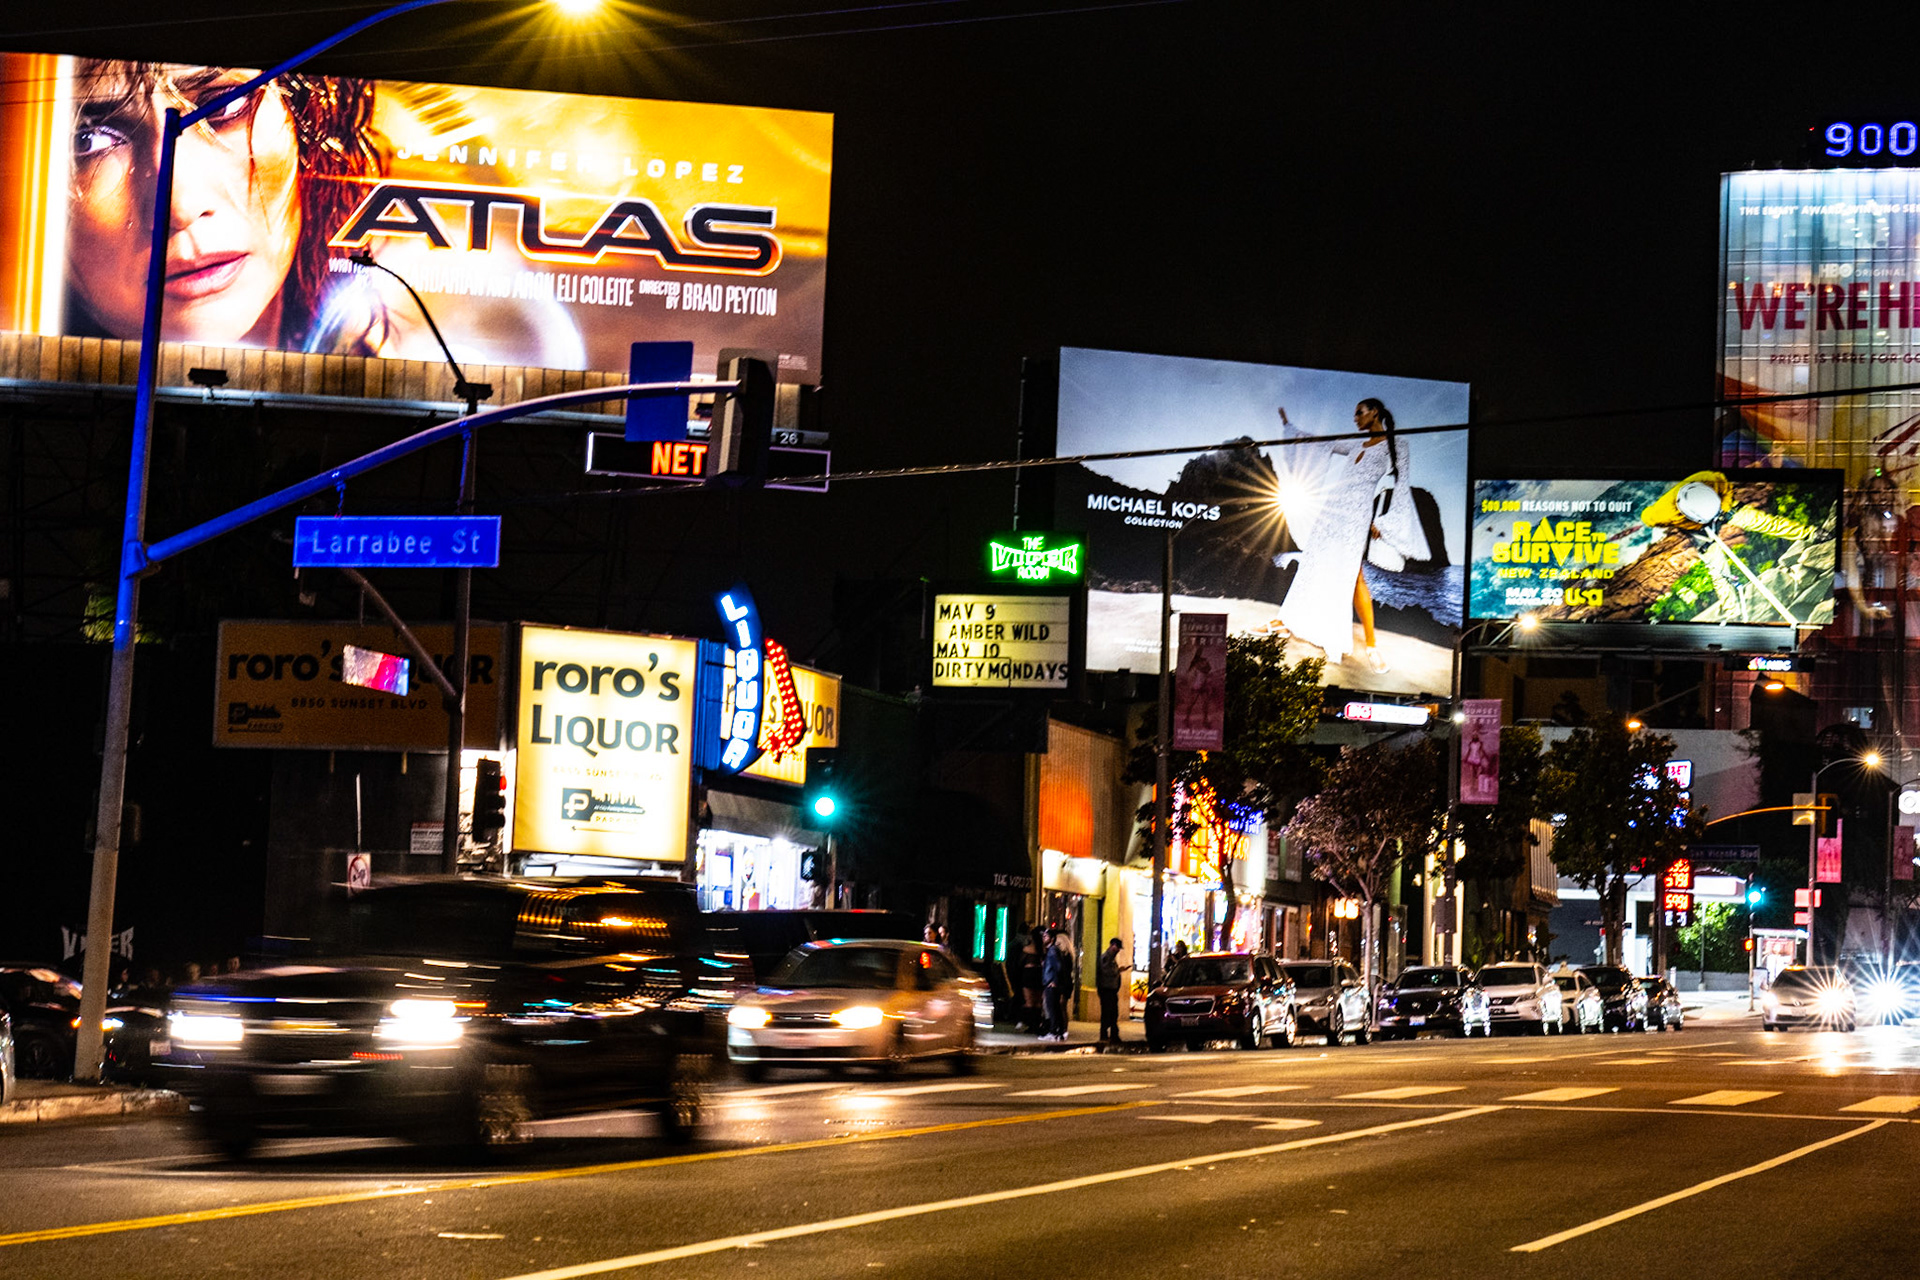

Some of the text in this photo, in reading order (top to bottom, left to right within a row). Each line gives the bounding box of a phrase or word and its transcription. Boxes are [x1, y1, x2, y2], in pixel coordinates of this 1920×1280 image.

[1824, 121, 1918, 157] 900
[623, 157, 744, 184] LOPEZ
[1739, 206, 1760, 216] THE
[328, 180, 783, 276] ATLAS
[1818, 263, 1906, 278] HBO ORIGINAL
[557, 273, 577, 303] ELI
[639, 279, 681, 296] DIRECTED
[665, 295, 681, 310] BY
[682, 282, 778, 317] BRAD PEYTON
[1769, 354, 1810, 364] PRIDE
[1814, 354, 1827, 364] IS
[1832, 353, 1866, 364] HERE
[1870, 353, 1898, 364] FOR
[779, 432, 799, 446] 26
[1087, 493, 1221, 521] MICHAEL KORS
[1522, 500, 1569, 512] REASONS
[1571, 501, 1591, 512] NOT
[1593, 501, 1607, 512] TO
[1608, 501, 1633, 513] QUIT
[1123, 515, 1184, 529] COLLECTION
[1511, 516, 1592, 543] RACE
[312, 526, 481, 555] Larrabee St
[1021, 536, 1044, 550] THE
[989, 541, 1080, 575] VIPER
[1492, 542, 1620, 567] SURVIVE
[1017, 565, 1050, 579] ROOM
[1497, 567, 1615, 580] NEW ZEALAND
[1505, 587, 1564, 599] MAY 20
[985, 604, 996, 620] 9
[949, 623, 1050, 641] AMBER WILD
[1181, 624, 1224, 633] SUNSET
[1181, 636, 1223, 646] STRIP
[936, 642, 1000, 658] MAY 10
[533, 653, 681, 702] roro's
[935, 662, 1069, 681] DIRTY MONDAYS
[721, 594, 759, 769] LIQUOR
[329, 699, 386, 711] SUNSET
[389, 699, 428, 711] BLVD
[1465, 707, 1498, 715] SUNSET
[530, 704, 680, 757] LIQUOR
